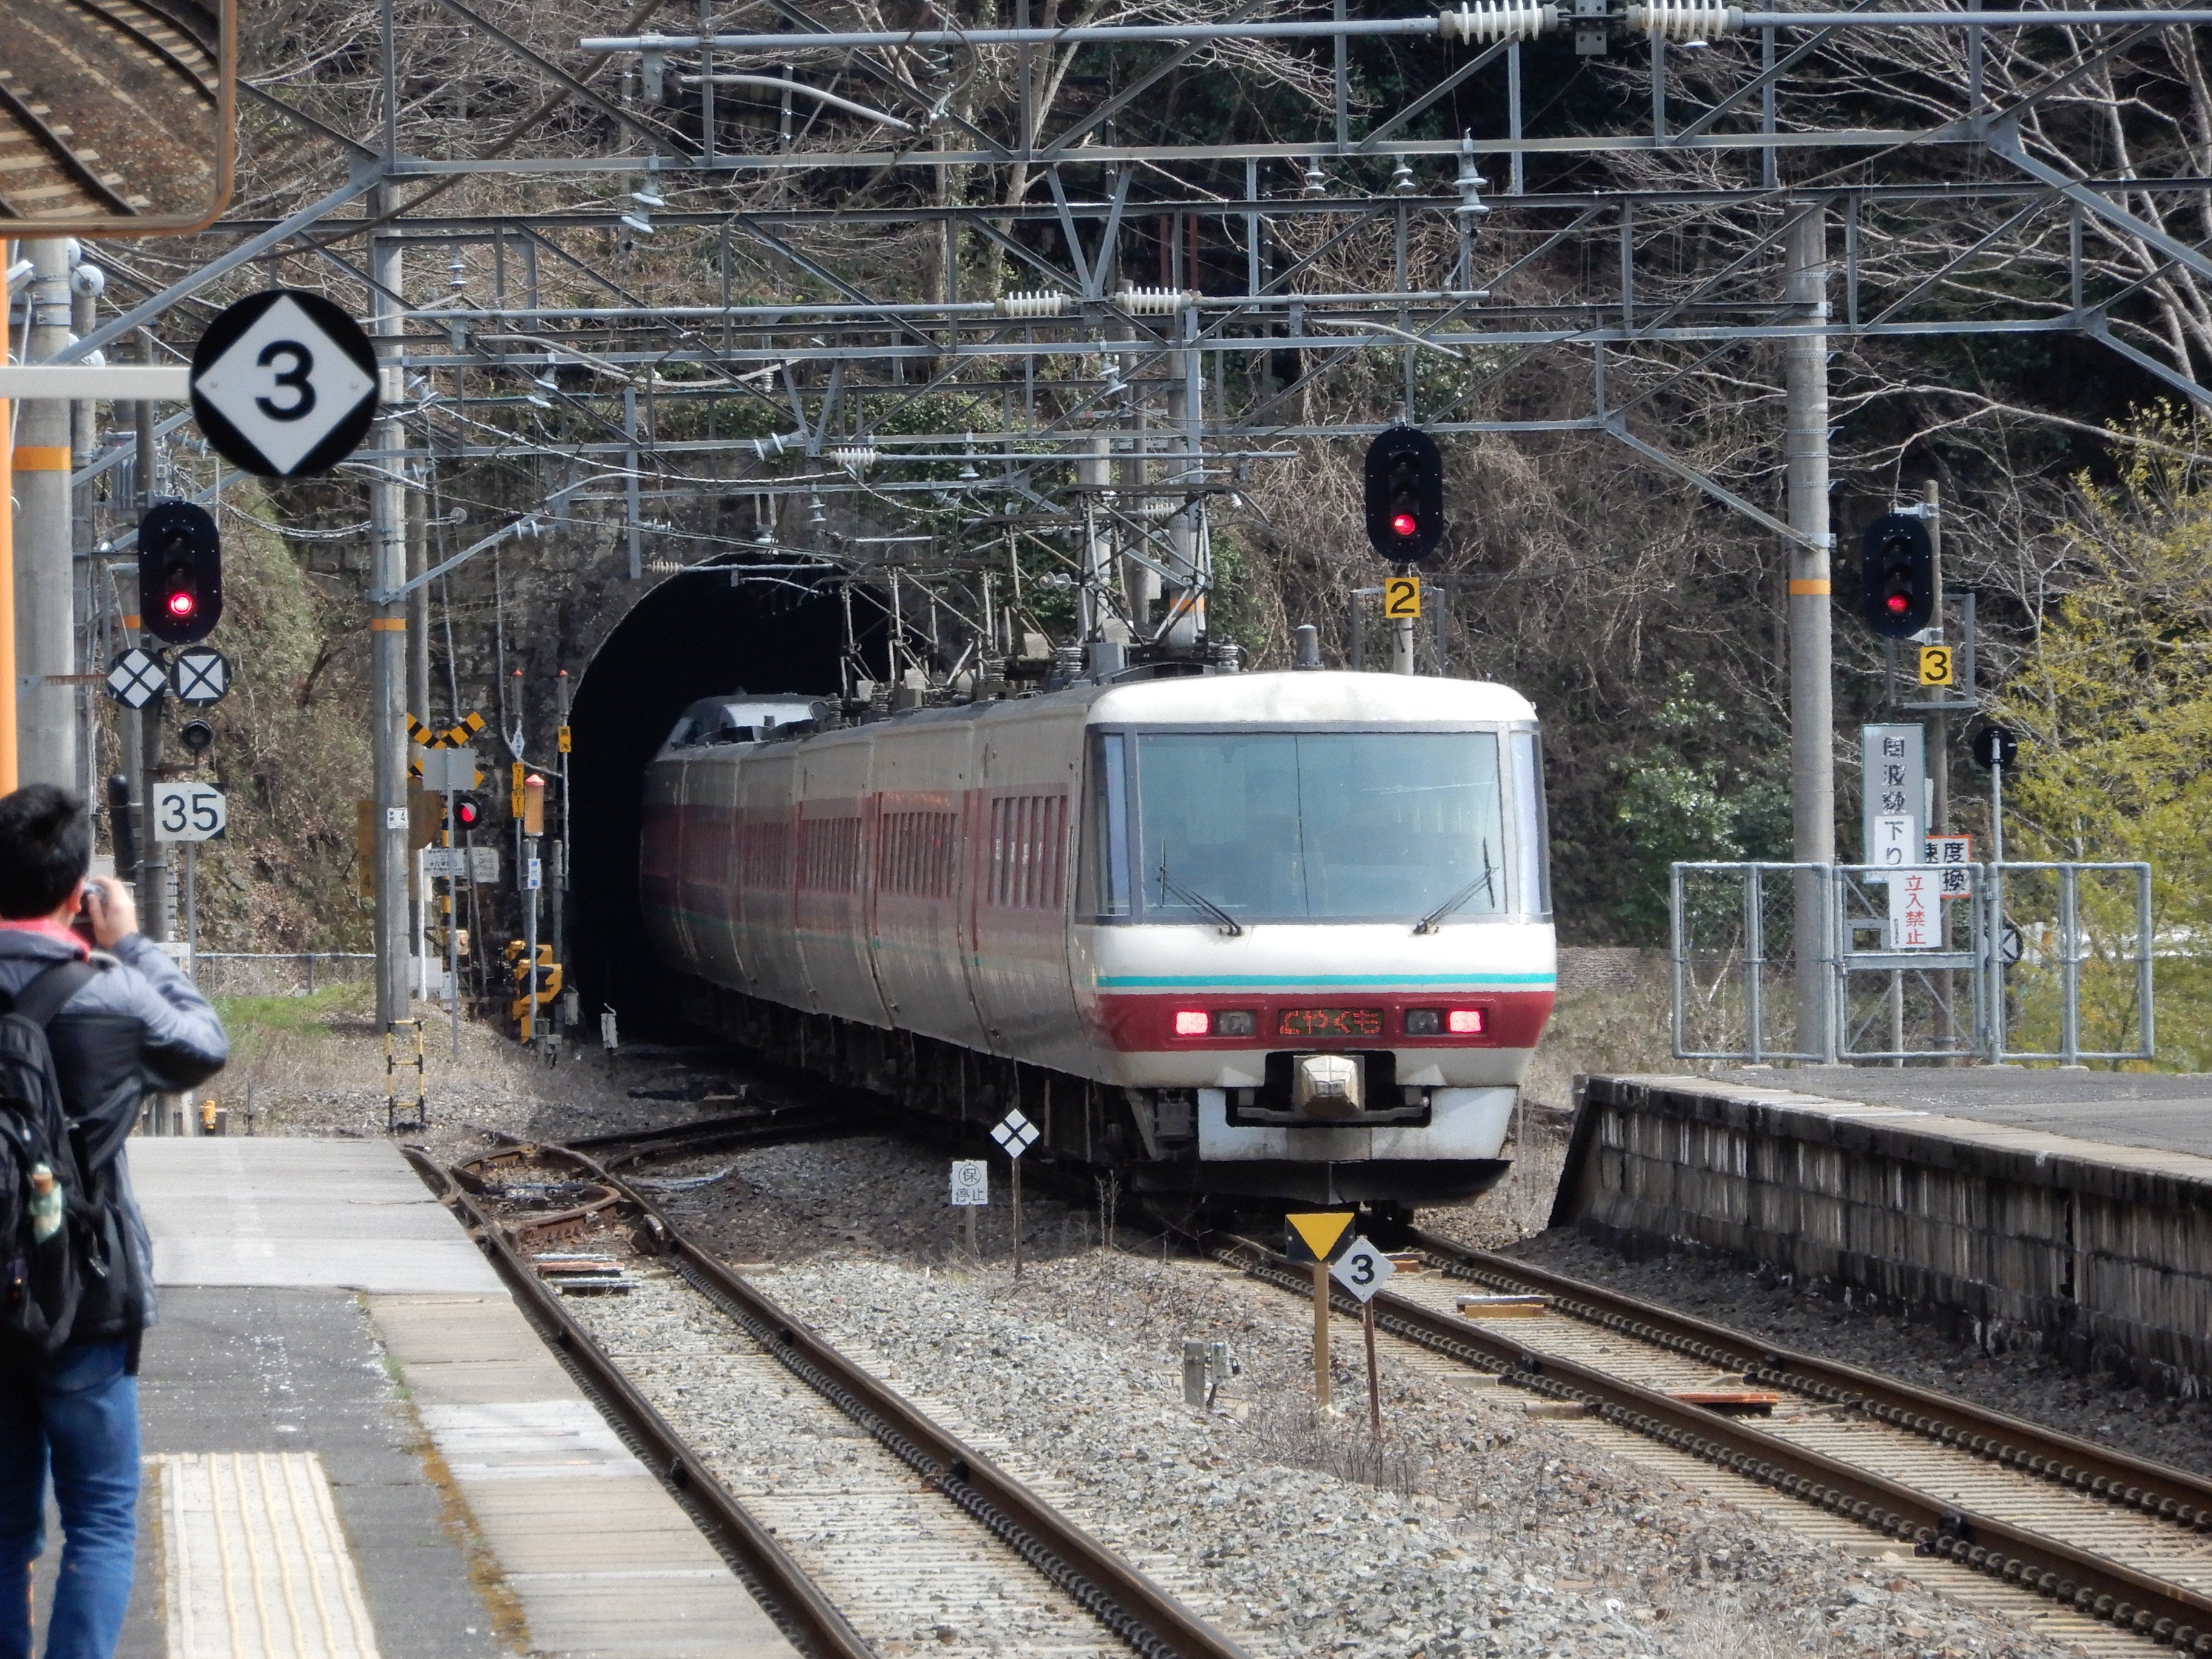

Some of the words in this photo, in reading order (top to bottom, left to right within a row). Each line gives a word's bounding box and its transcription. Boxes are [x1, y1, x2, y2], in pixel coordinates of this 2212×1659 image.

[255, 340, 316, 423] 3
[1390, 581, 1416, 614] 2
[1925, 650, 1948, 682] 3
[162, 793, 218, 833] 35
[1903, 874, 1927, 946] 立入禁止
[955, 1188, 985, 1203] 停止
[1350, 1254, 1375, 1286] 3
